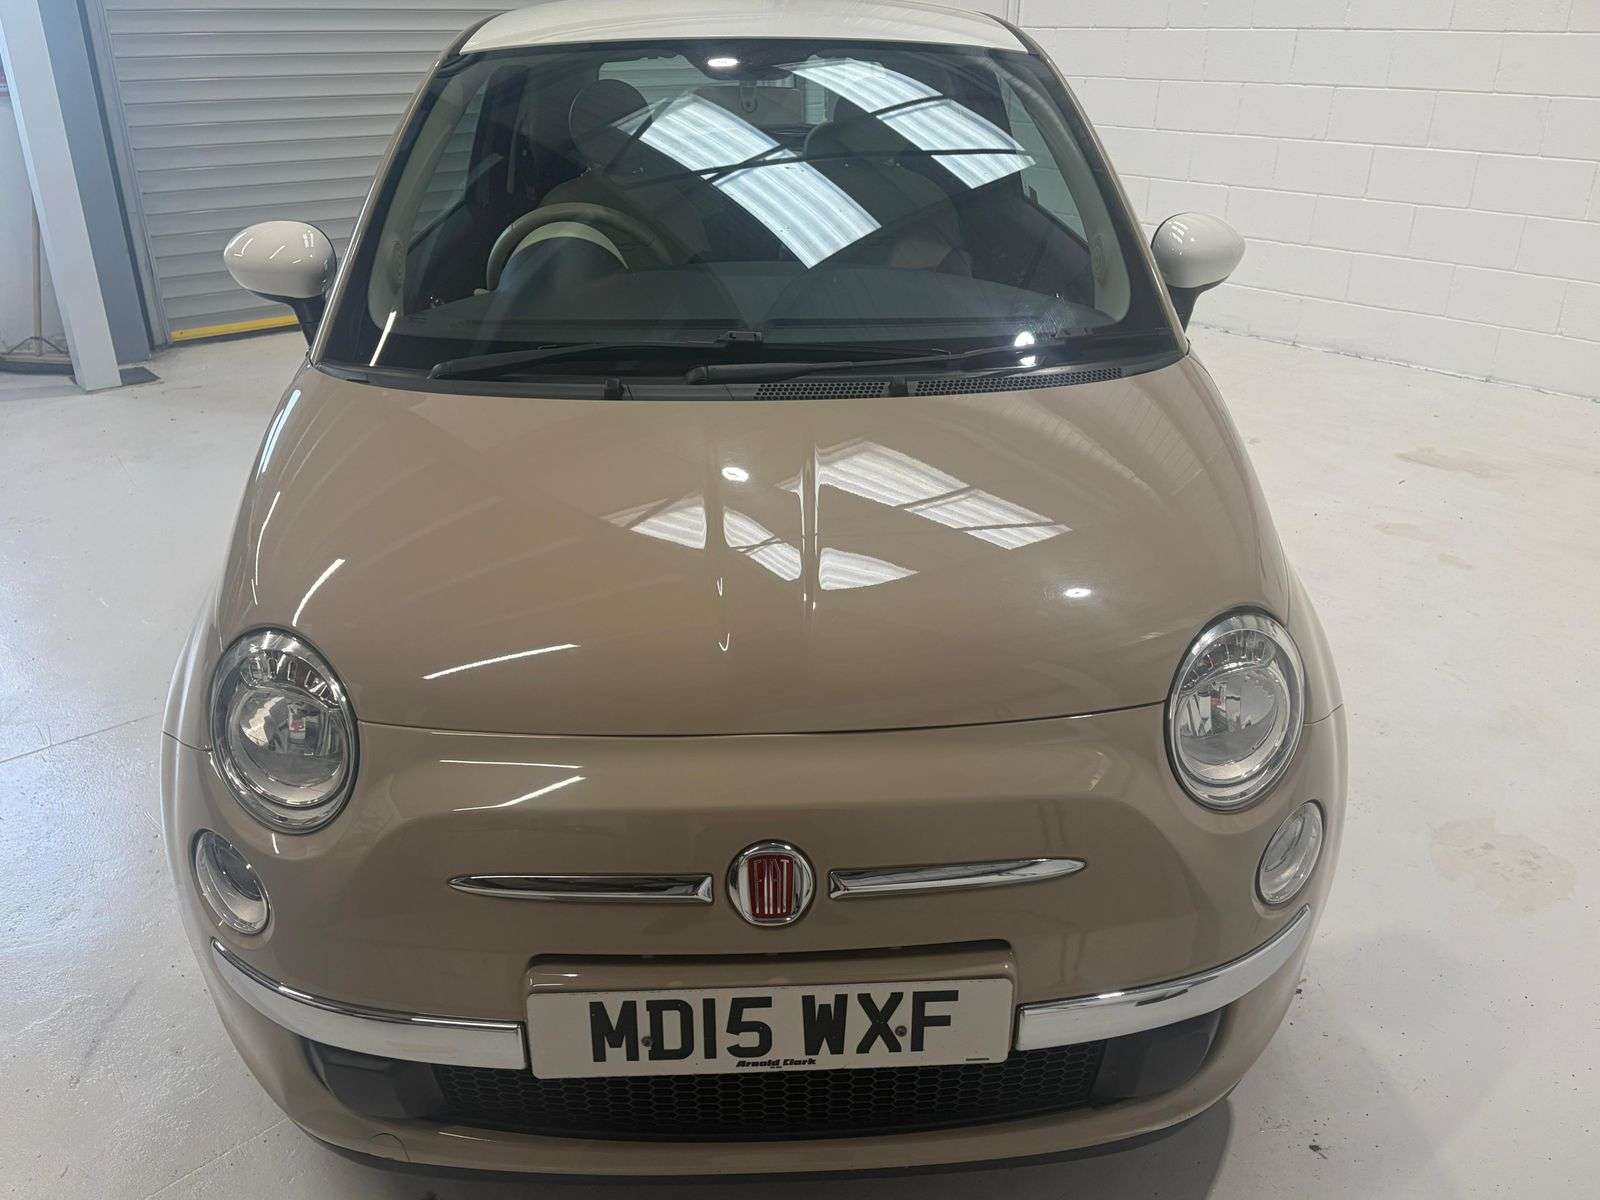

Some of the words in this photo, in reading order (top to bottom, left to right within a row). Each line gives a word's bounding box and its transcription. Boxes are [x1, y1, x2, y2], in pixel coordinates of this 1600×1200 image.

[753, 858, 790, 915] FIAT
[589, 996, 773, 1063] MD15
[802, 989, 960, 1056] WXF
[736, 1059, 781, 1067] Arnold
[782, 1057, 817, 1066] Clark
